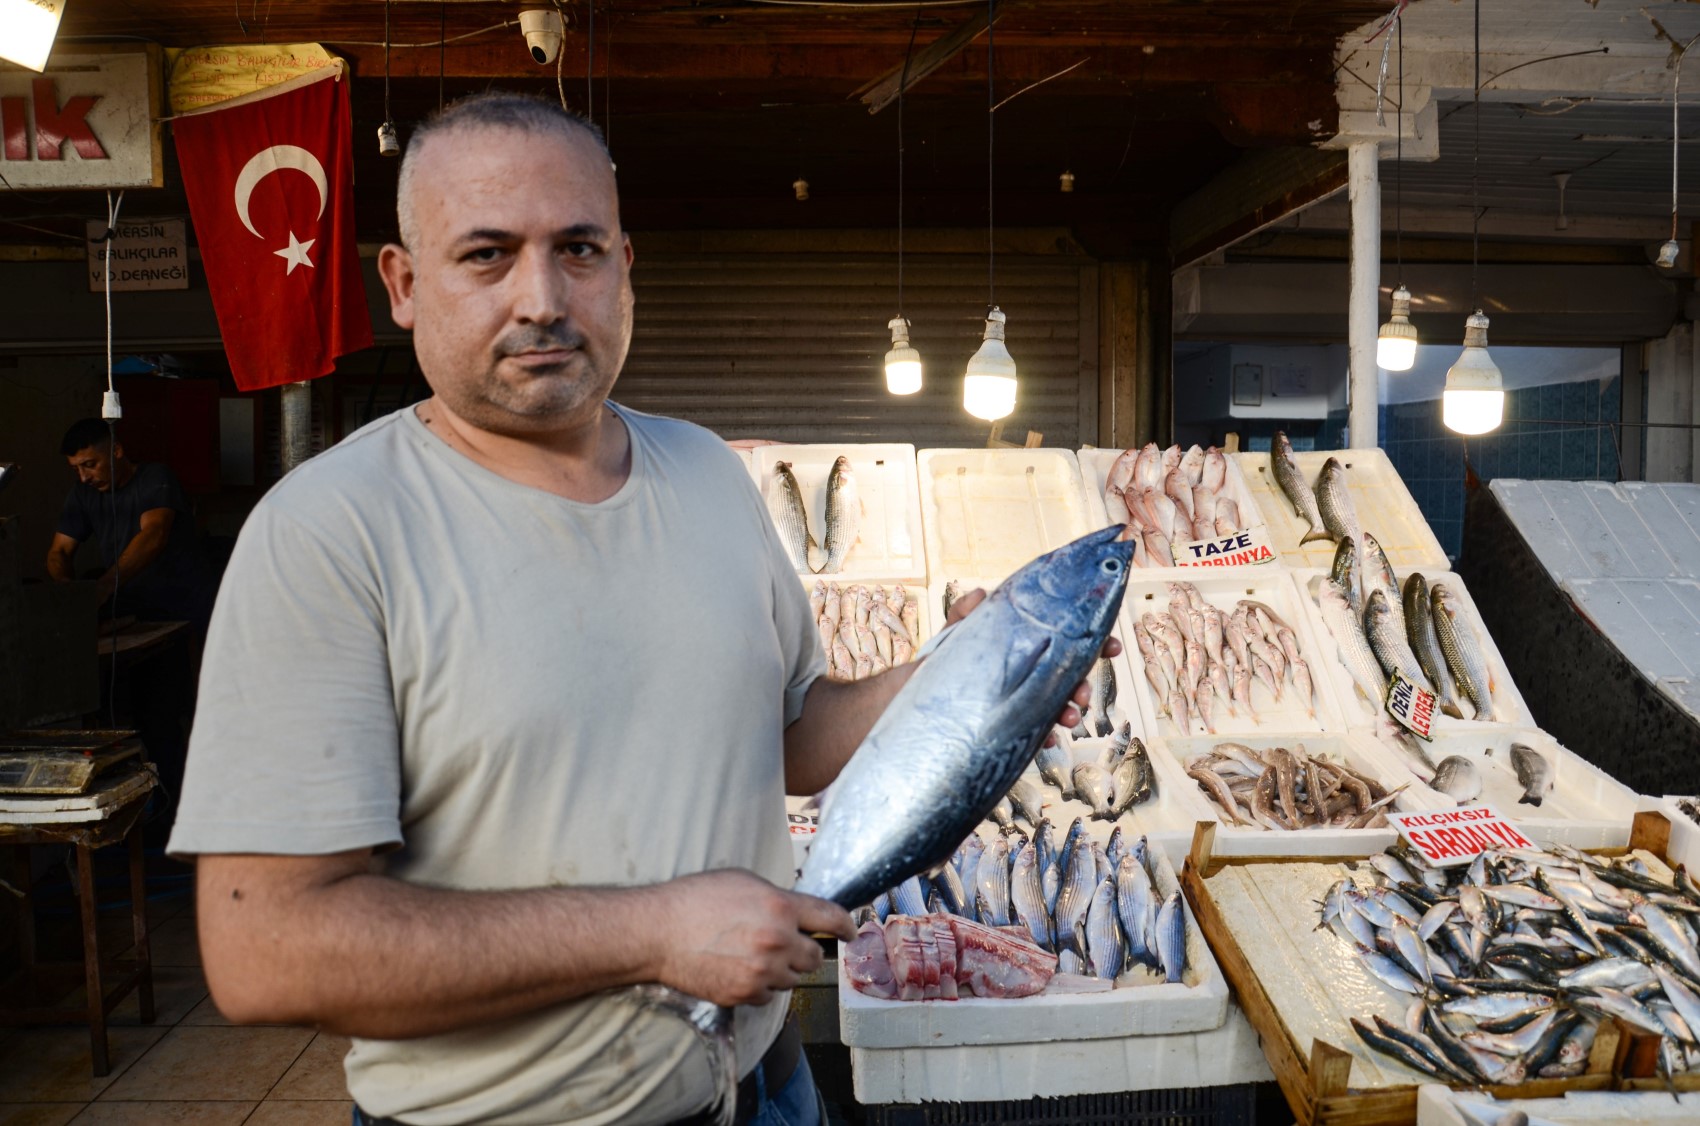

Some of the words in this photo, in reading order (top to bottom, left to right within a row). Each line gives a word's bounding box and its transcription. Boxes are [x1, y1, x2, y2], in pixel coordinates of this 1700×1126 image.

[1189, 533, 1252, 558] TAZE
[1411, 687, 1435, 737] LEVREK
[1399, 808, 1496, 827] KILÇIKSIZ
[1408, 821, 1533, 860] SARDALYA
